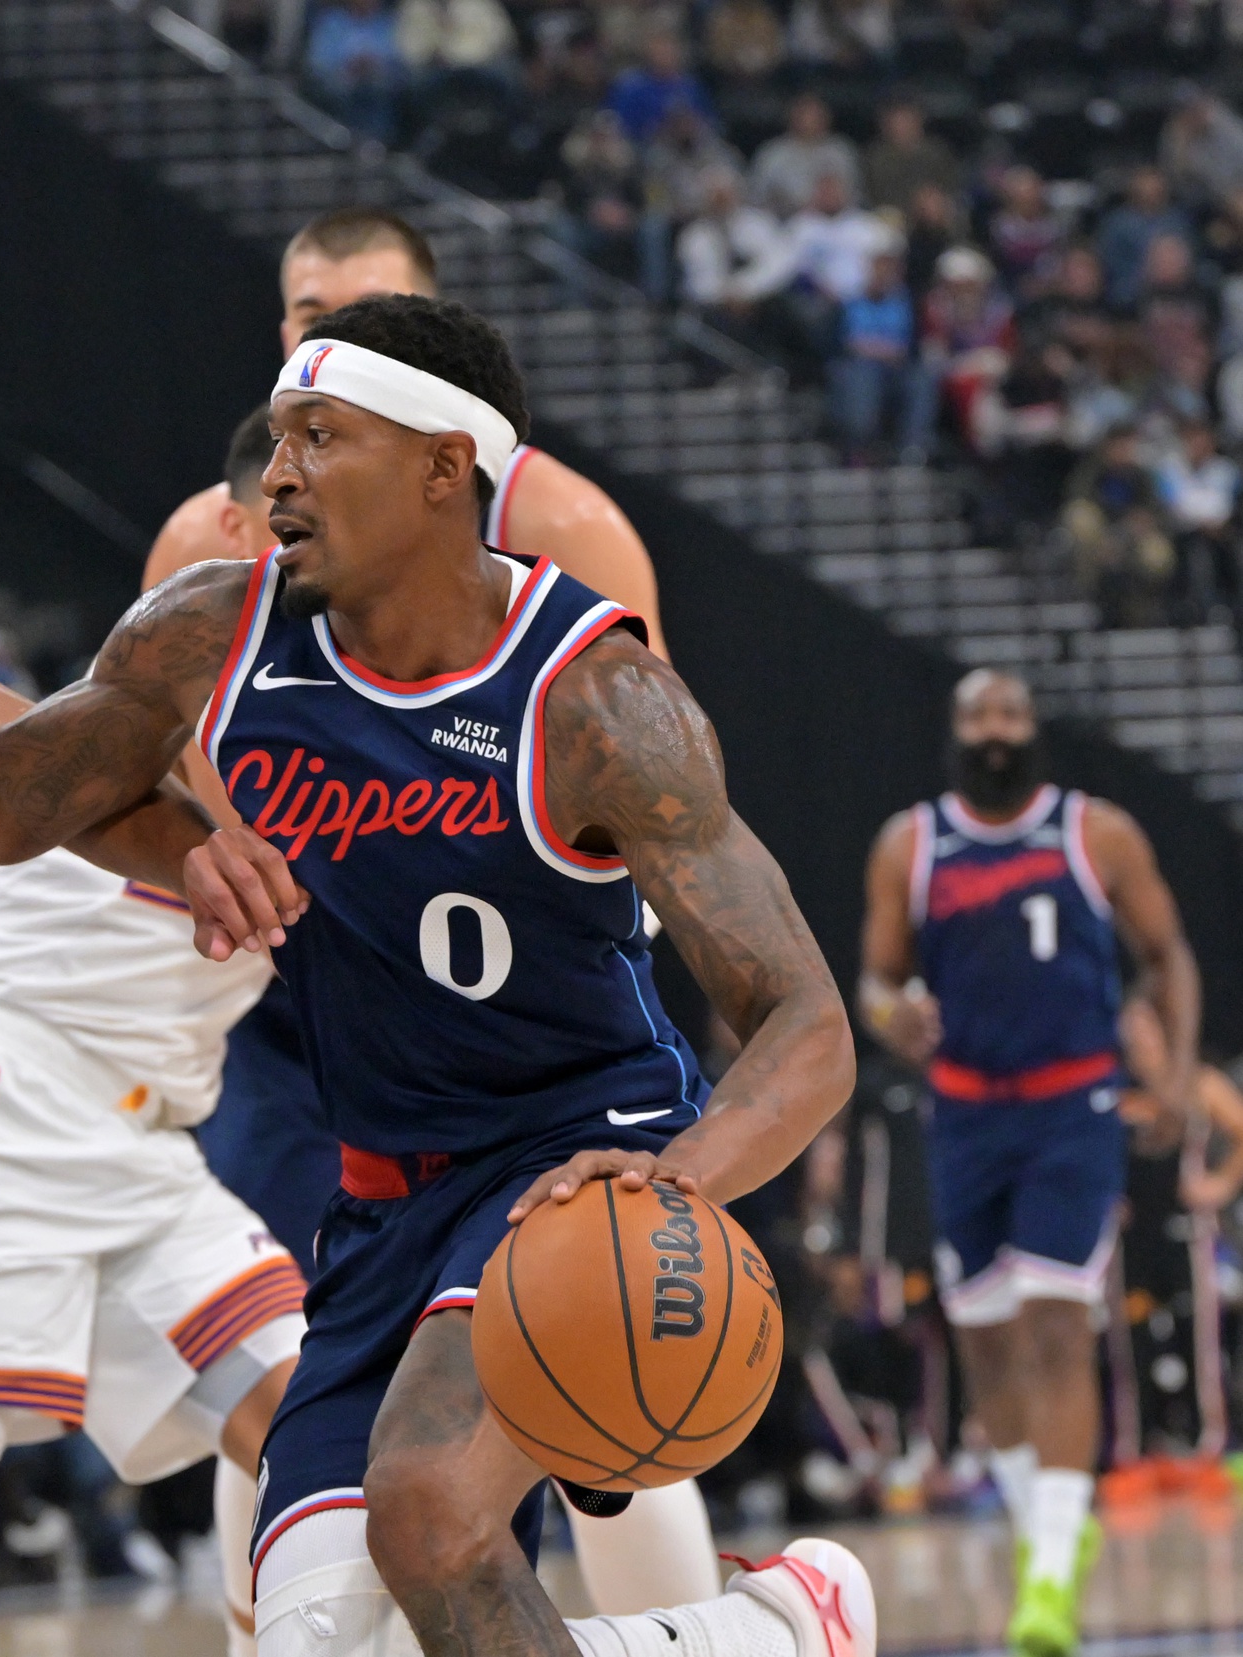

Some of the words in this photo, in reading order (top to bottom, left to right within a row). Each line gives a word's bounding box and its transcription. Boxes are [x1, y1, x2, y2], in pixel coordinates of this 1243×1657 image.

[430, 728, 508, 763] RWANDA
[454, 716, 501, 742] VISIT
[227, 748, 510, 862] Clippers
[419, 892, 513, 1002] 0
[1020, 893, 1058, 962] 1
[649, 1179, 706, 1342] Wilson
